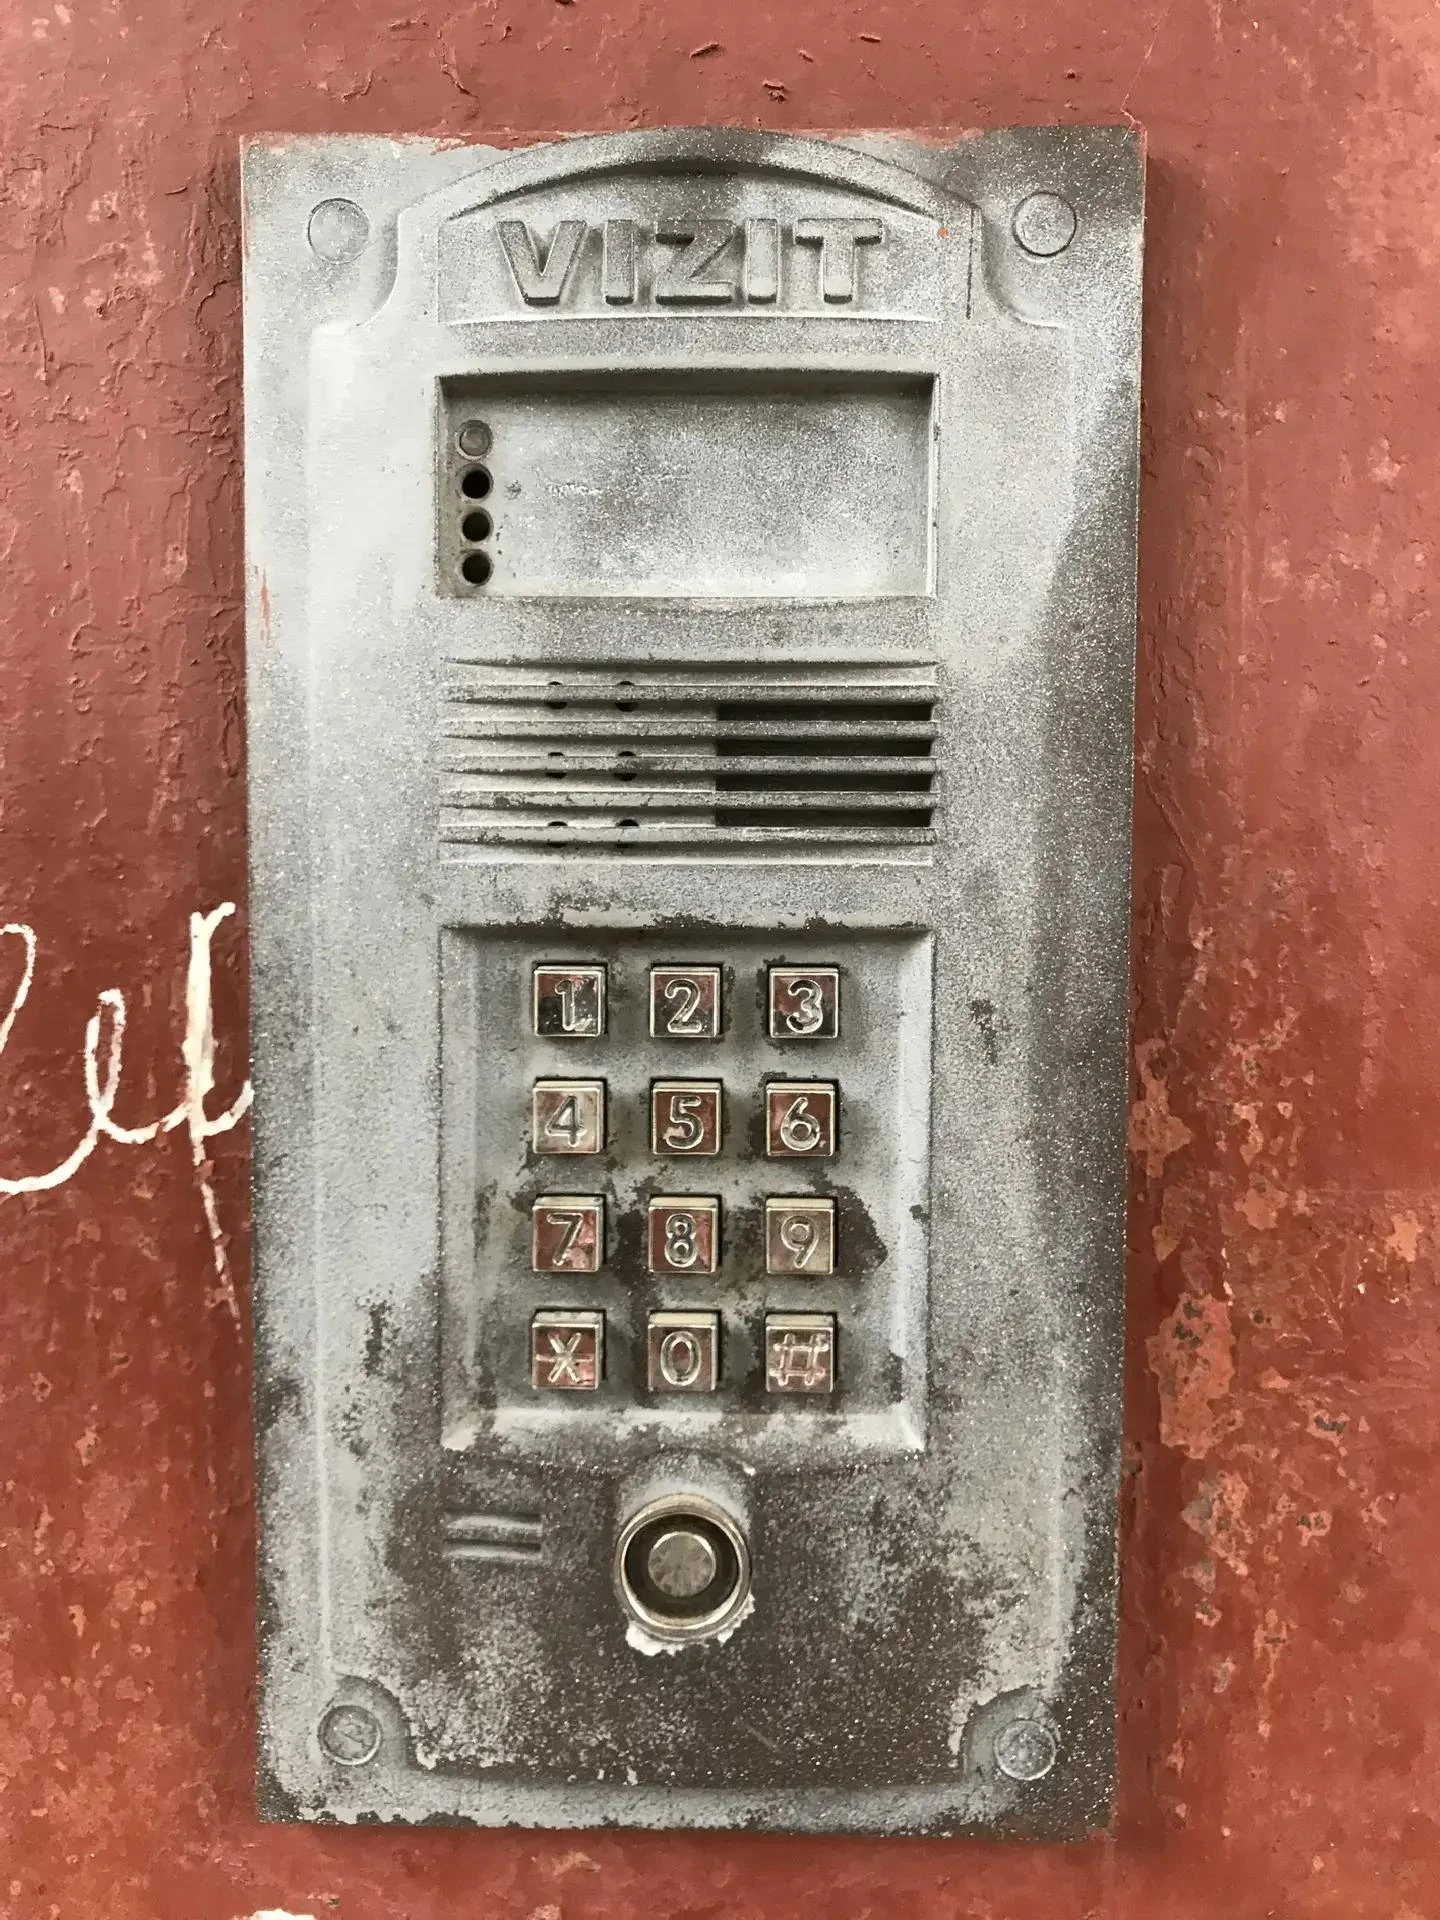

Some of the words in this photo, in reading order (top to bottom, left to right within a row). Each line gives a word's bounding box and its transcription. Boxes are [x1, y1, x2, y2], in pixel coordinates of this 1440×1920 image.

[497, 217, 884, 306] VIZIT
[555, 979, 576, 1032] 1
[665, 979, 704, 1034] 2
[786, 979, 824, 1034] 3
[545, 1095, 587, 1148] 4
[665, 1095, 704, 1149] 5
[780, 1096, 820, 1151] 6
[546, 1212, 584, 1266] 7
[664, 1213, 698, 1268] 8
[780, 1215, 820, 1269] 9
[768, 1332, 829, 1386] #
